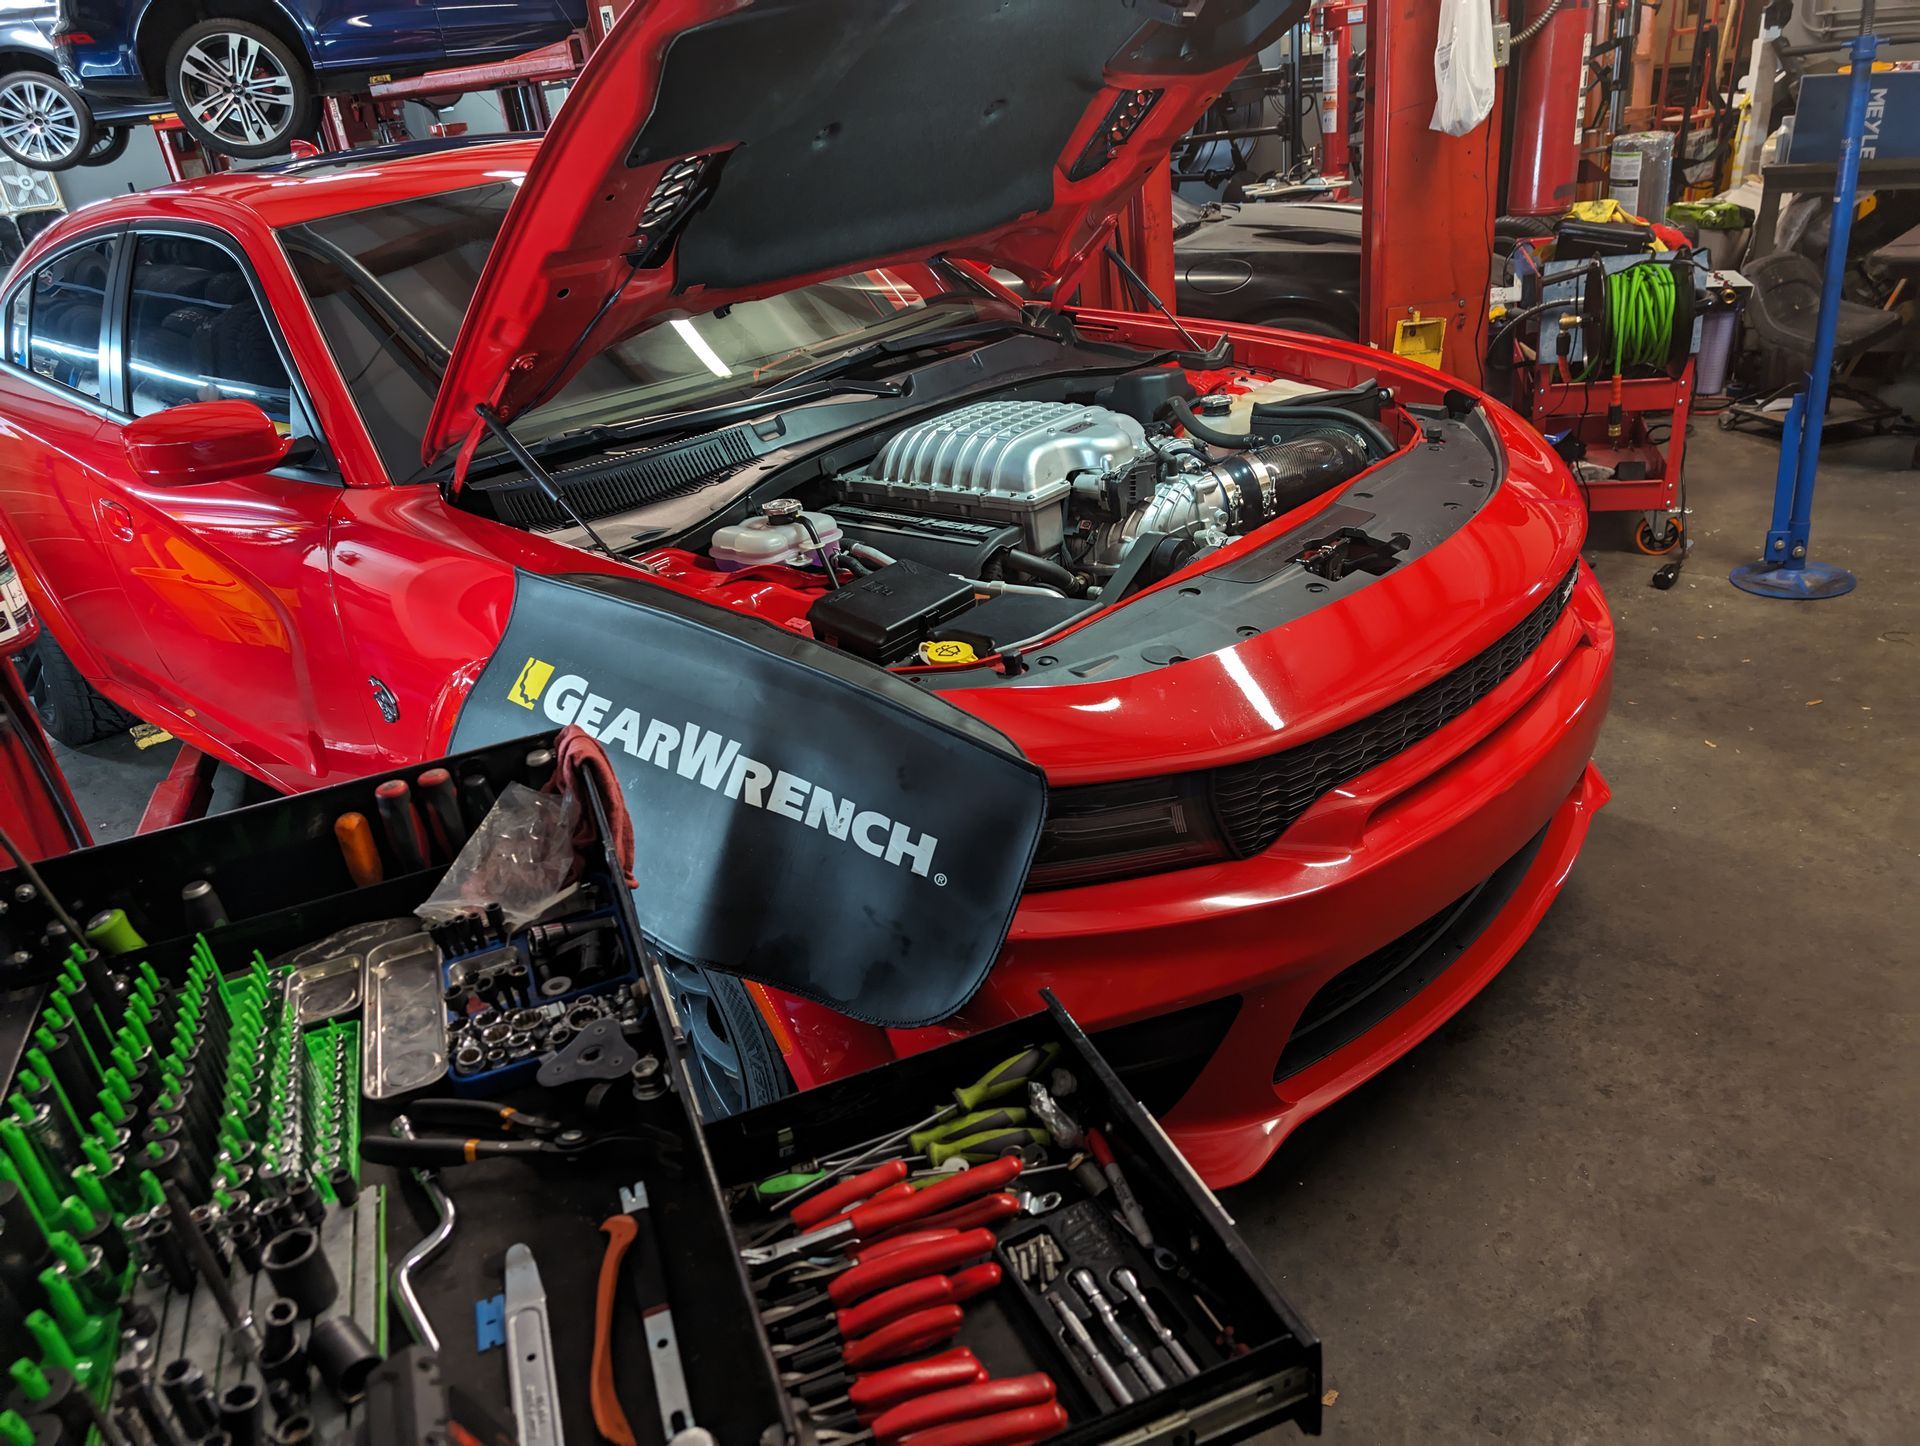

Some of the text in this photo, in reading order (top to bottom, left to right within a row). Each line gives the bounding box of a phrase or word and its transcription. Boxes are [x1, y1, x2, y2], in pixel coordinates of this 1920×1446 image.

[1860, 88, 1888, 160] MEYLE
[919, 519, 996, 534] HEMI
[543, 674, 938, 878] GEARWRENCH
